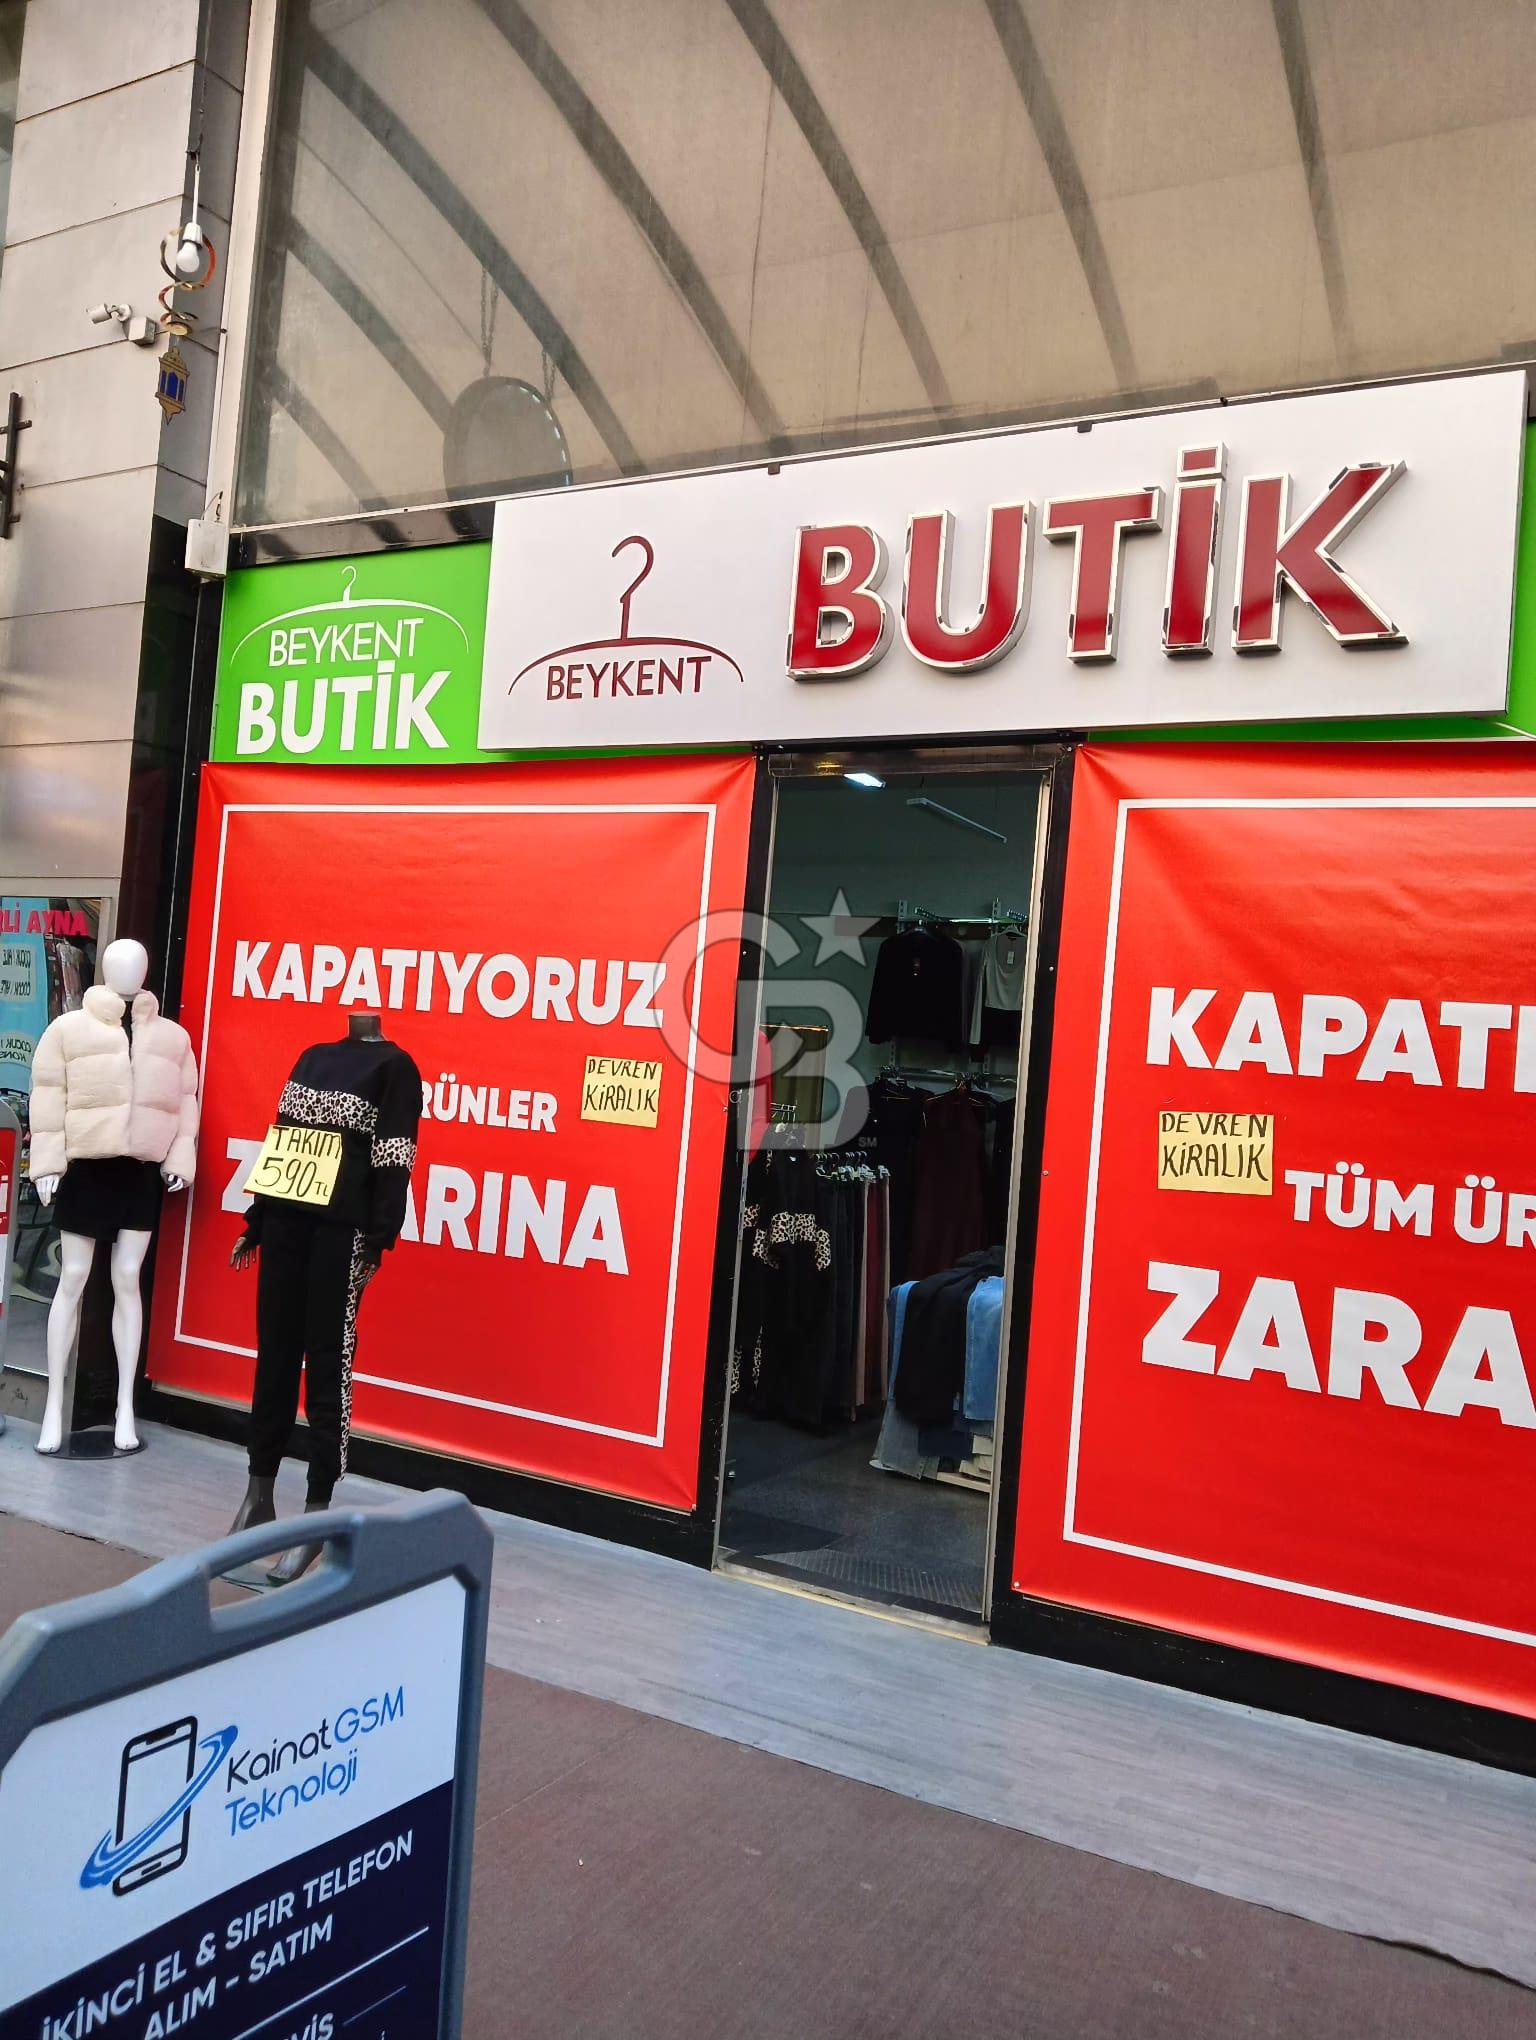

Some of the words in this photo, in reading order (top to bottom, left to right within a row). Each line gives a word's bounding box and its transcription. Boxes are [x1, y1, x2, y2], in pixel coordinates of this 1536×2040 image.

[786, 440, 1409, 681] BUTİK
[268, 617, 424, 668] BEYKENT
[547, 656, 712, 701] BEYKENT
[236, 658, 452, 755] BUTİK
[26, 909, 90, 937] AYNA
[232, 940, 667, 1028] KAPATIYORUZ
[421, 1072, 558, 1133] ÜNLER
[588, 1058, 658, 1080] DEVREN
[1161, 1112, 1269, 1138] DEVREN
[1284, 1161, 1435, 1237] TÜM
[1141, 1261, 1536, 1430] ZARA
[225, 1749, 358, 1836] Teknoloji
[153, 1950, 187, 1994] EL
[195, 1933, 217, 1967] &
[225, 1892, 296, 1951] SIFIR
[303, 1829, 413, 1906] TELEFON
[144, 1976, 216, 2040] ALIM
[249, 1913, 333, 1985] SATIM
